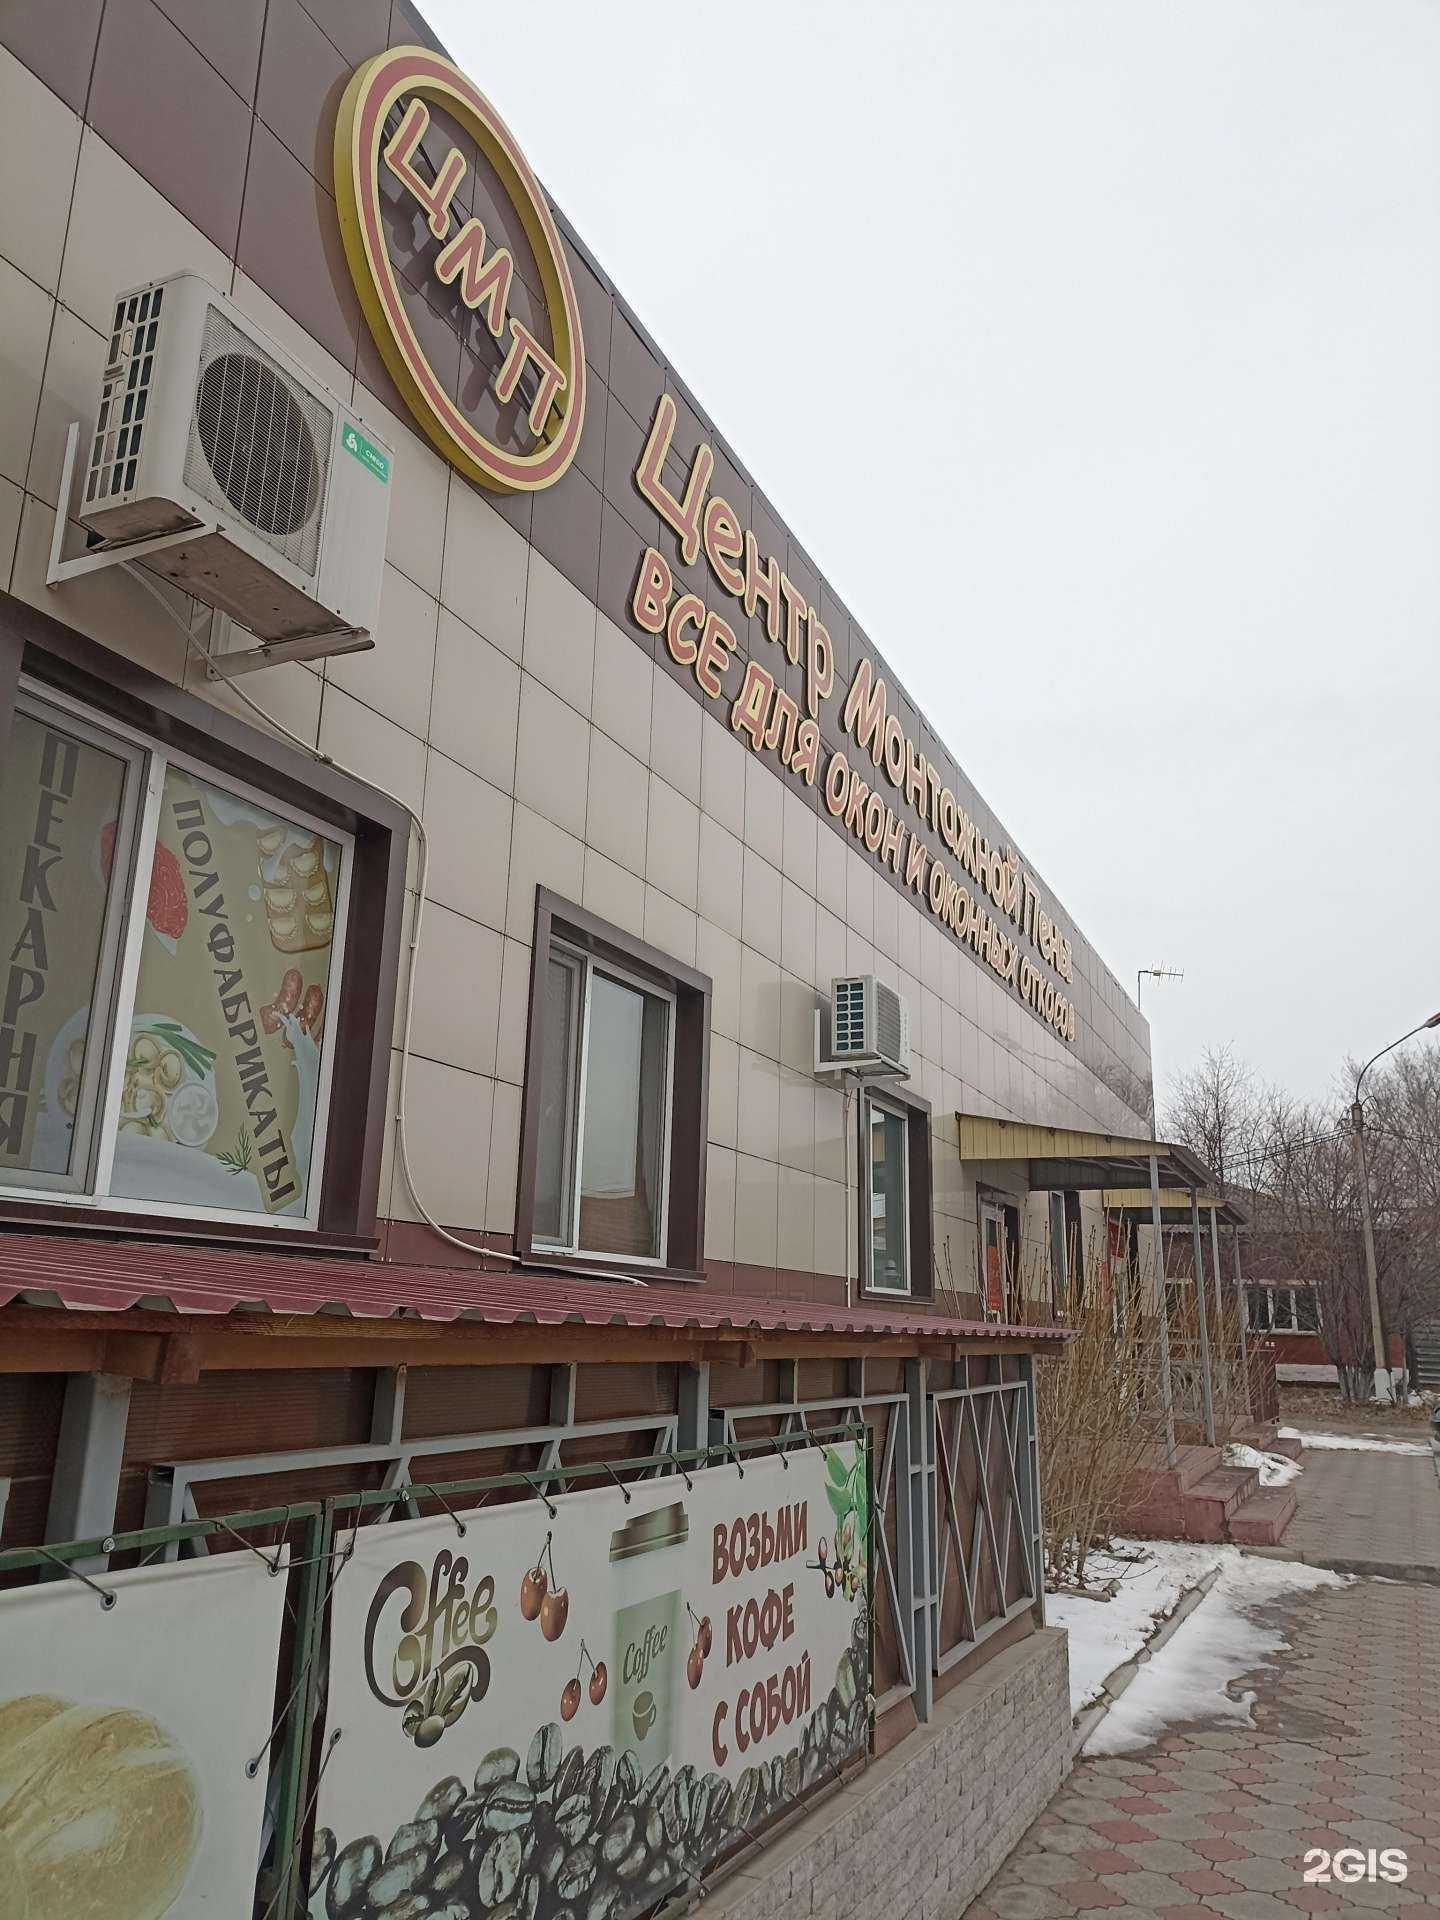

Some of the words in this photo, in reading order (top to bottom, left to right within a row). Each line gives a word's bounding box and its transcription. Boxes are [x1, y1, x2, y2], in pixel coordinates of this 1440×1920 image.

[384, 98, 567, 436] ЦМП
[633, 547, 736, 699] ВСЕ
[732, 660, 820, 785] ДЛЯ
[825, 751, 905, 873] ОКОН
[906, 832, 928, 895] И
[929, 860, 1018, 982] ОКОННЫХ
[1020, 955, 1075, 1042] ОТКОСОВ
[636, 393, 834, 718] Центр
[844, 658, 1019, 925] Монтажной
[1023, 871, 1073, 984] Пены
[0, 732, 79, 1155] ПЕКАРНЯ
[172, 800, 295, 1202] ПОЛУФАБРИКАТЫ
[364, 1549, 498, 1707] Coffee
[623, 1623, 668, 1686] Coffee
[712, 1500, 808, 1585] ВОЗЬМИ
[726, 1583, 795, 1667] КОФЕ
[712, 1700, 728, 1767] С
[735, 1650, 811, 1754] СОБОЙ
